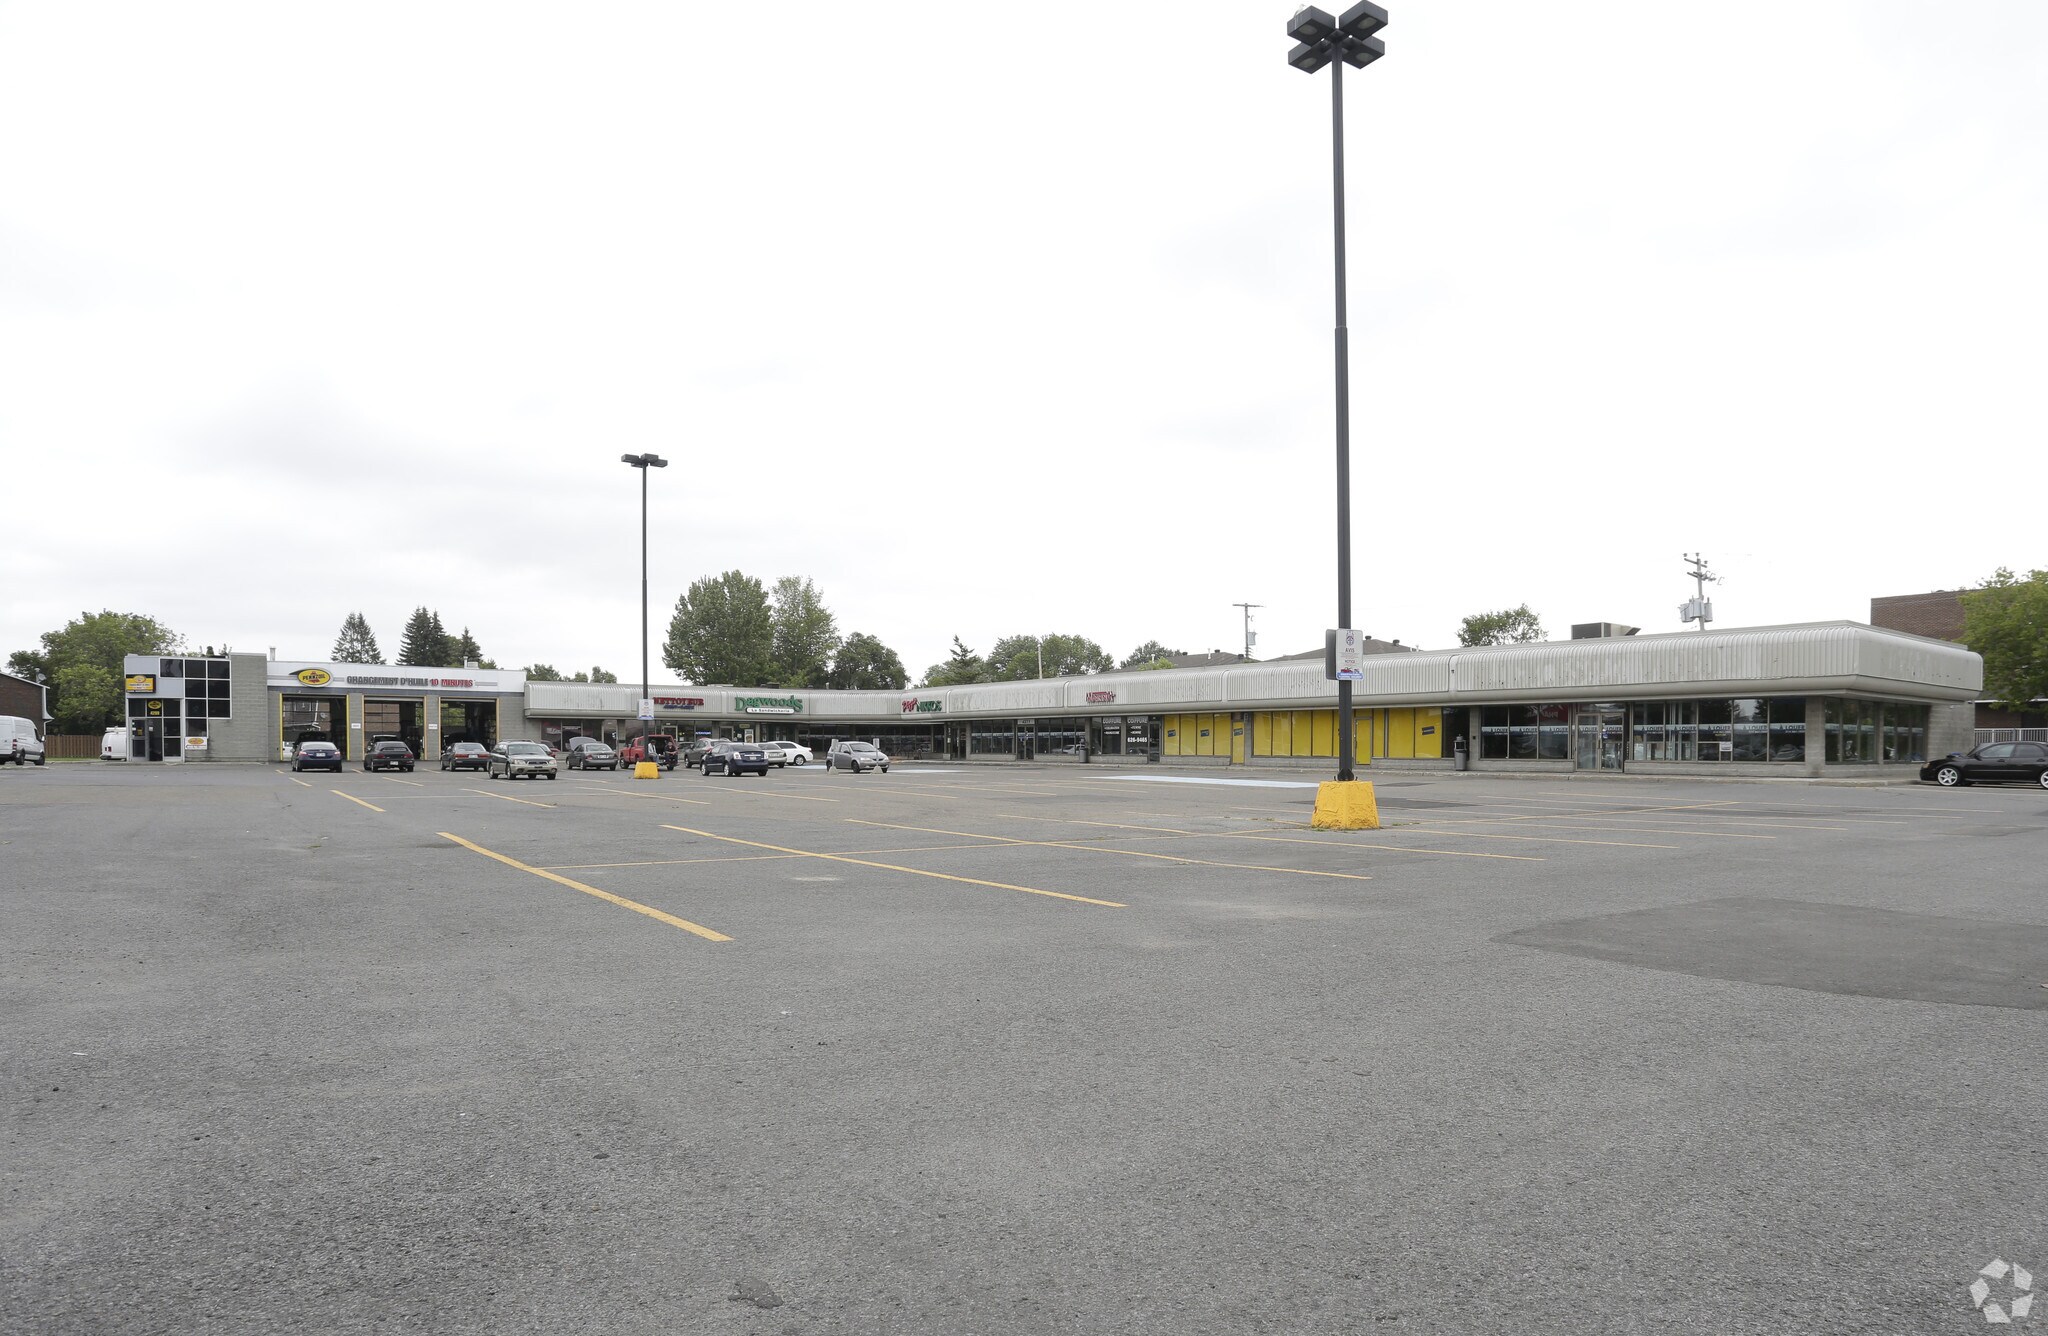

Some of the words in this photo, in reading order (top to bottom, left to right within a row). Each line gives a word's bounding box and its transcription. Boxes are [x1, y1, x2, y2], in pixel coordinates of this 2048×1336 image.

[346, 676, 398, 686] CHANGEMENT
[400, 678, 428, 686] D'HUILE
[442, 679, 474, 688] MINUTES
[653, 697, 704, 706] NETTOYEUR
